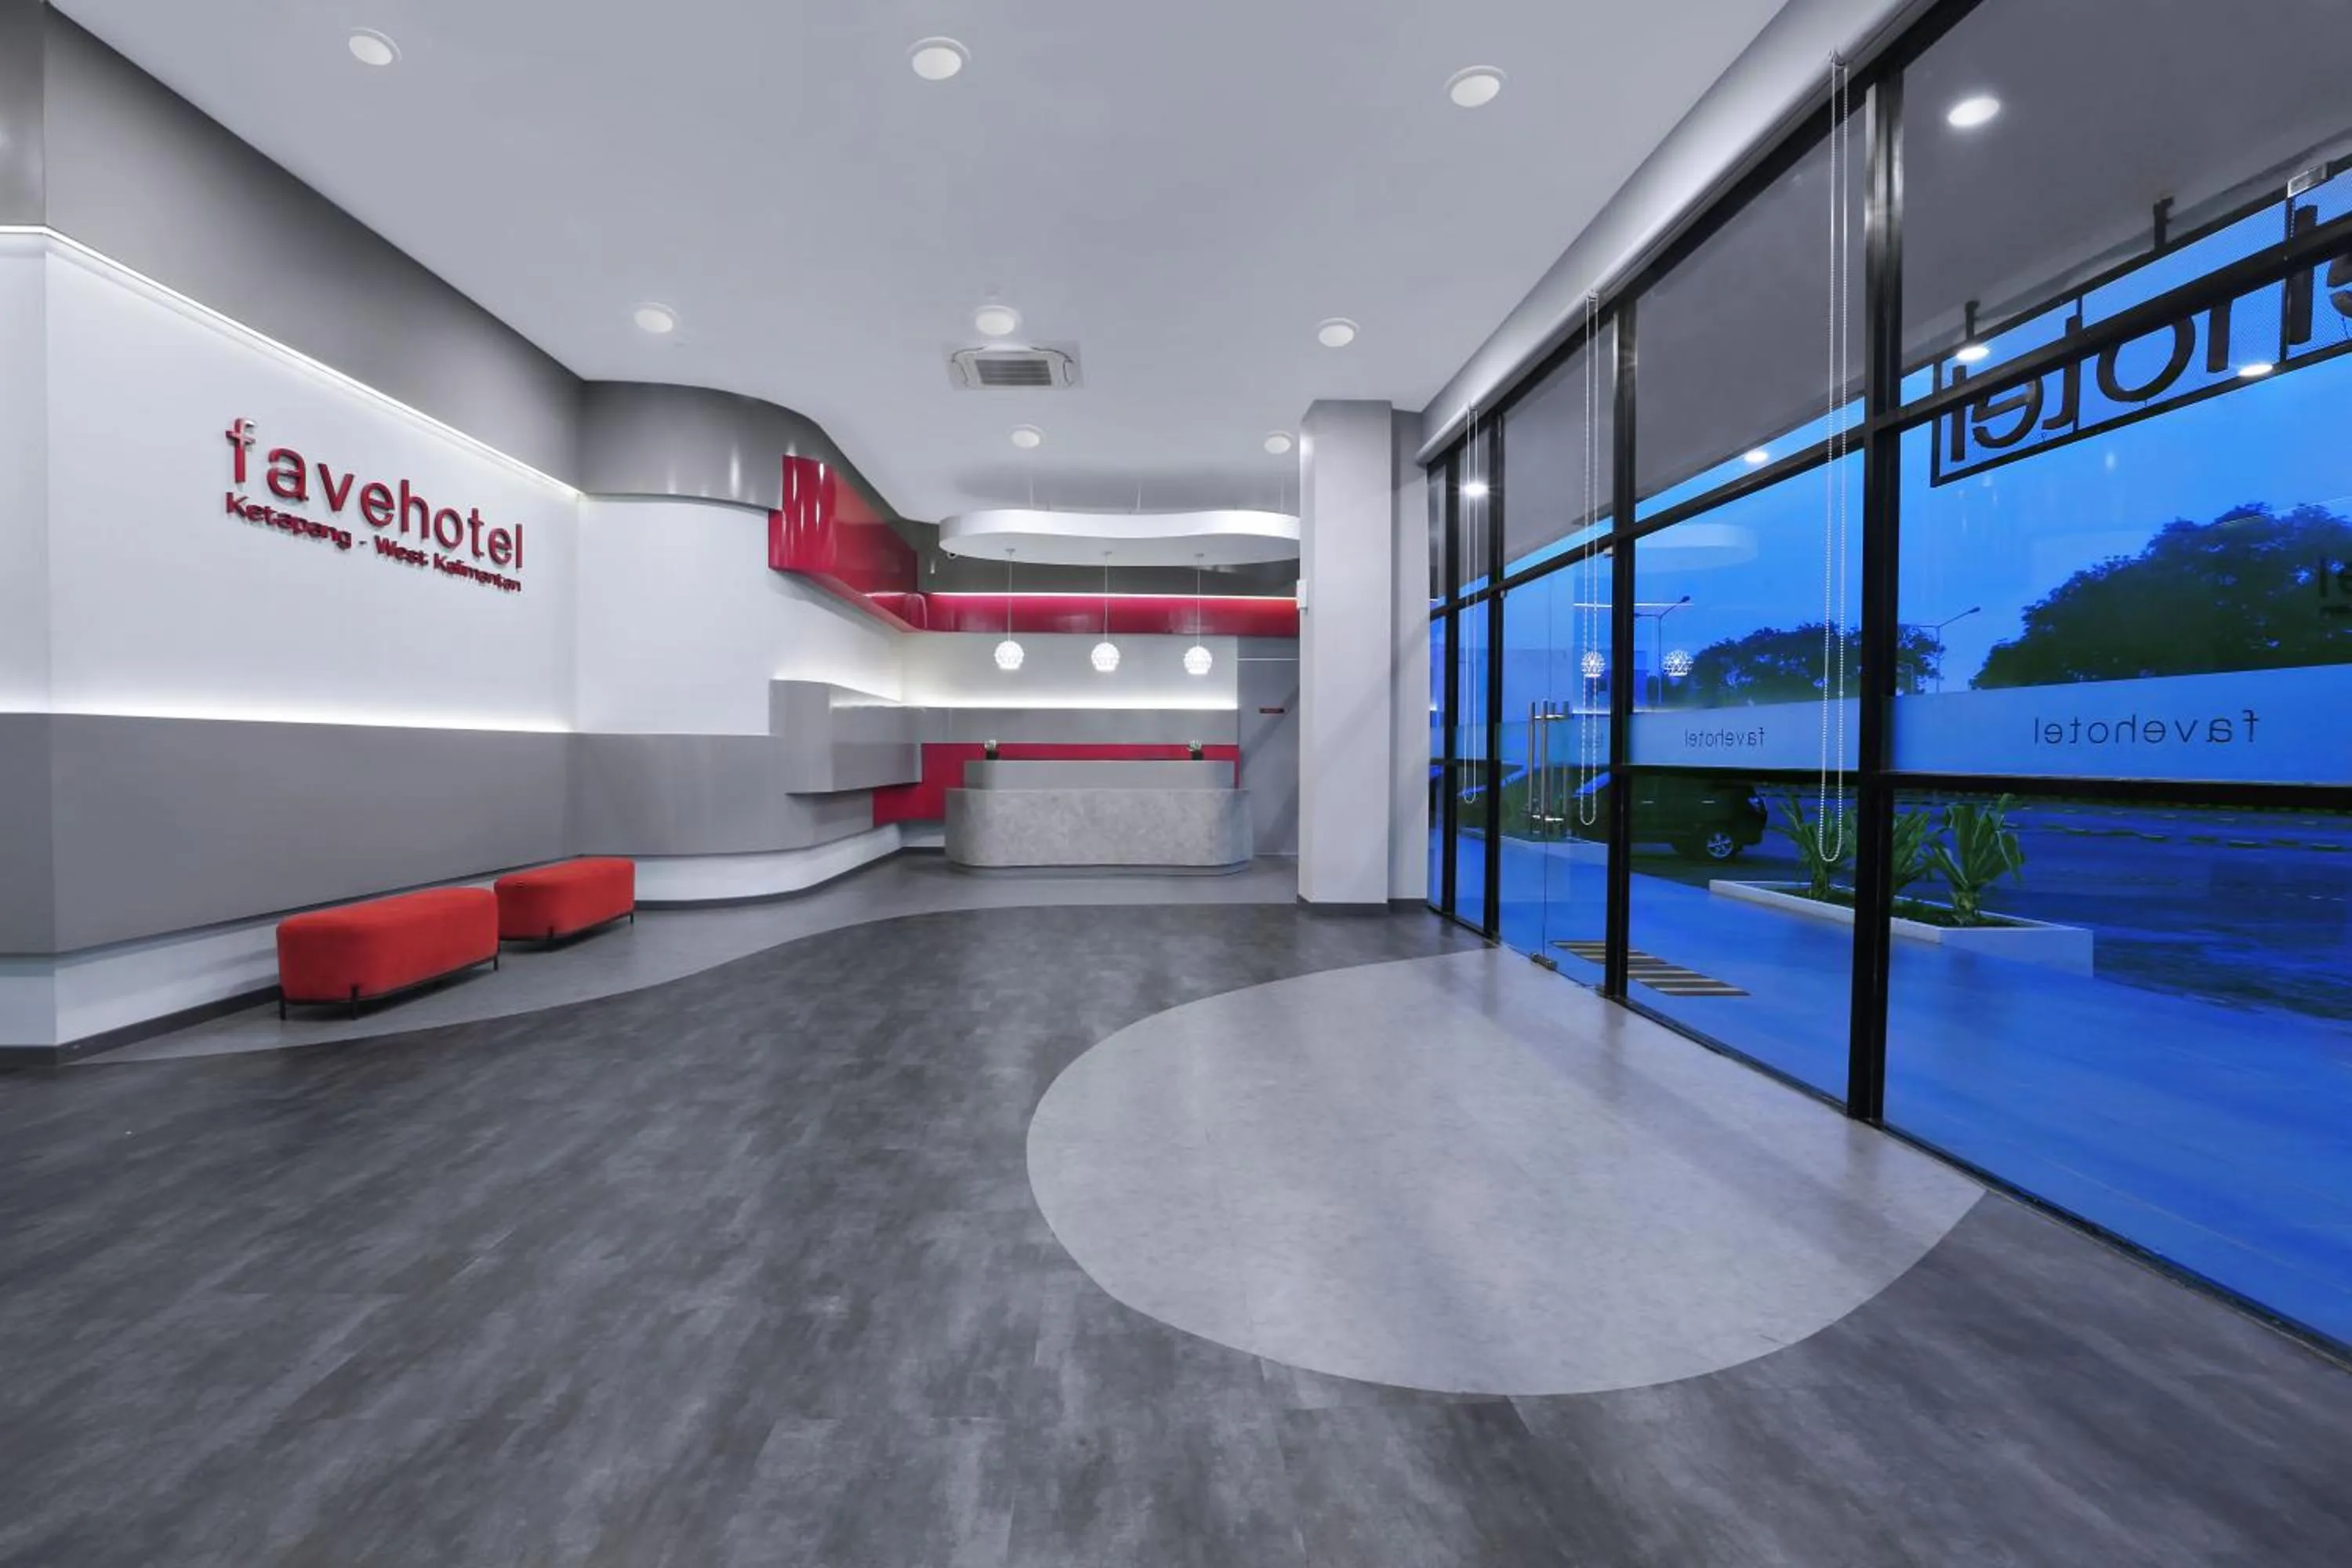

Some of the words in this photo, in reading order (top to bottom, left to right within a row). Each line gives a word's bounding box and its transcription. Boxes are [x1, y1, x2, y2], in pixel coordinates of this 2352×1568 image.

[226, 417, 524, 572] favehotel
[226, 492, 353, 550] Ketapang
[374, 535, 429, 566] West
[433, 552, 522, 593] Kalimantan
